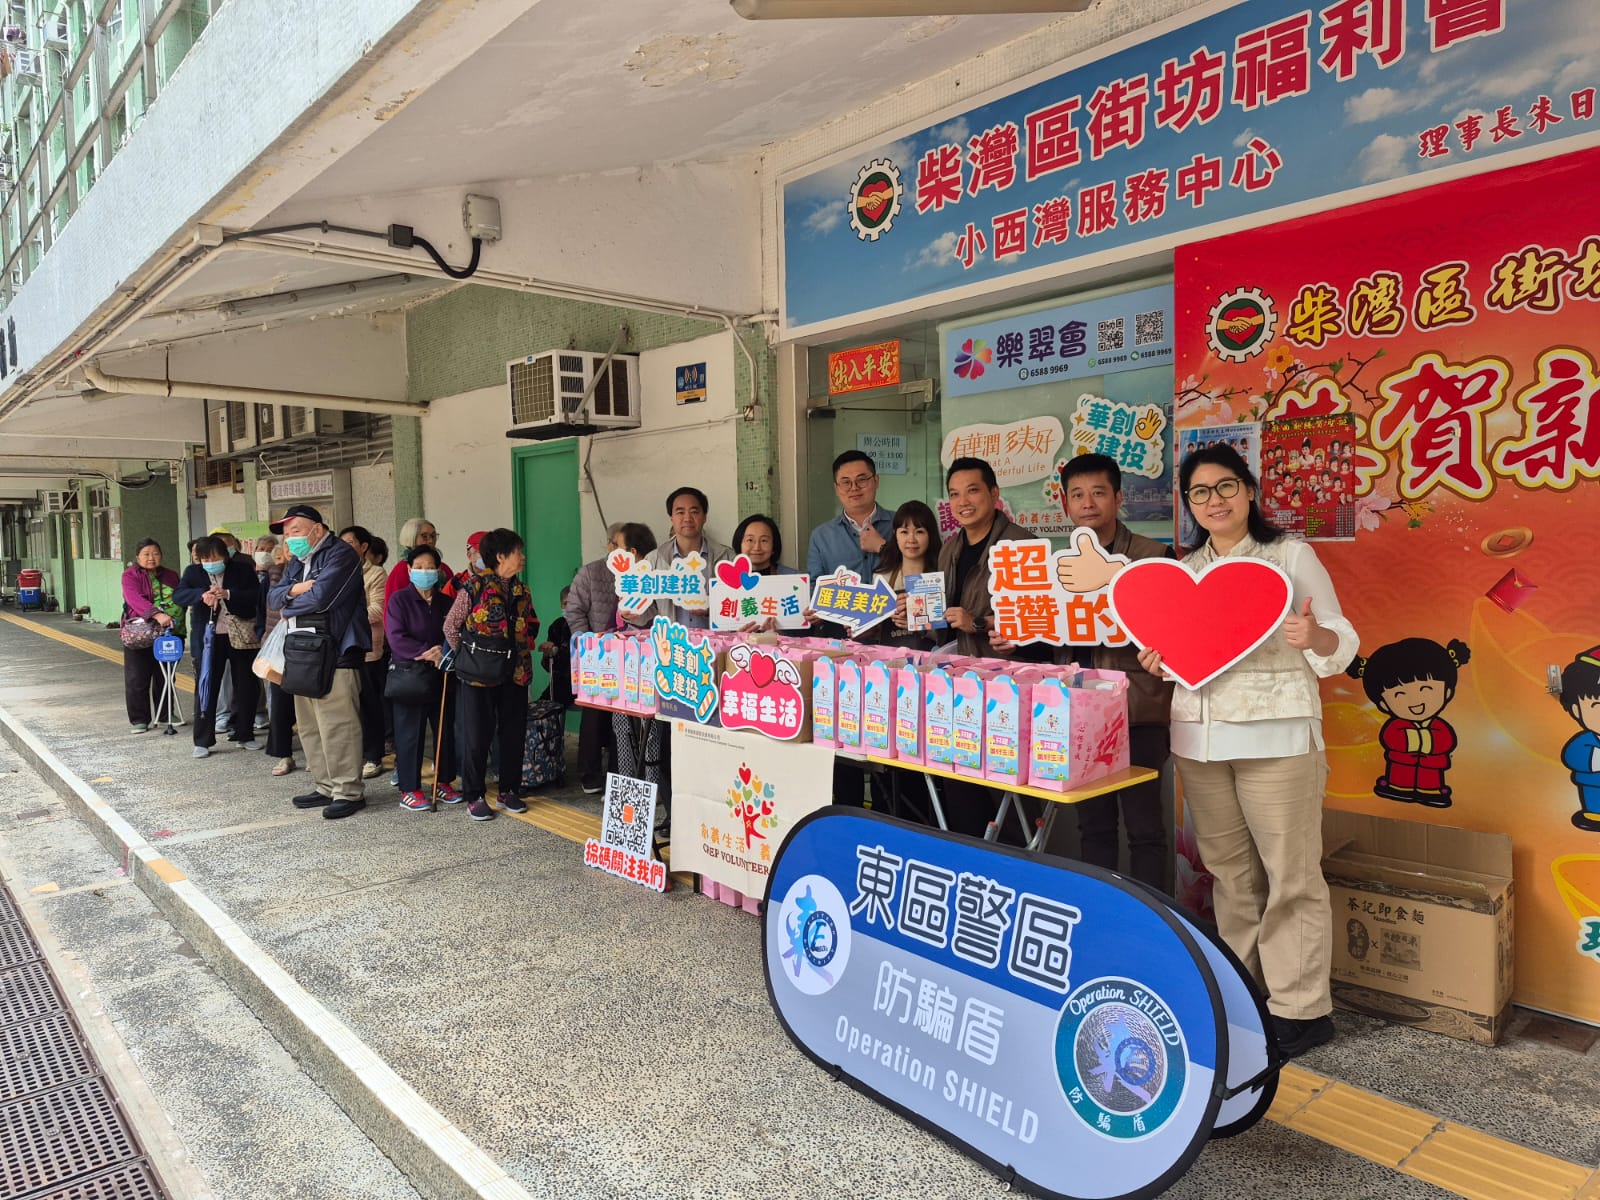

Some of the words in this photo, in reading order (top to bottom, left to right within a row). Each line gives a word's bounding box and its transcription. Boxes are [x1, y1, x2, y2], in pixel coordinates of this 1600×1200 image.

[954, 137, 1284, 269] 小西灣服務中心
[996, 320, 1088, 369] 樂翠會
[834, 350, 893, 386] 出入平安
[1030, 367, 1049, 377] 6588
[1050, 364, 1069, 375] 9969
[1086, 402, 1137, 437] 華創
[1005, 424, 1056, 457] 多美好
[1095, 434, 1147, 470] 建投
[996, 465, 1025, 477] derful
[1028, 462, 1046, 473] Life
[1004, 456, 1011, 466] A
[1040, 525, 1075, 533] VOLUNTE
[620, 574, 700, 595] 華創建投
[992, 544, 1053, 592] 超
[719, 594, 801, 619] 創義生活
[816, 586, 888, 616] 匯聚美好
[996, 594, 1127, 643] 讚的
[672, 644, 698, 676] 華創
[672, 671, 699, 703] 建投
[722, 689, 798, 728] 幸福生活
[586, 842, 664, 890] 掃碼關注我們
[851, 845, 1080, 993] 東區警區
[873, 960, 1005, 1067] 防騙盾
[1069, 984, 1126, 1016] Operation
[1129, 989, 1180, 1046] SHIELD
[835, 1014, 936, 1092] Operation
[942, 1069, 1040, 1145] SHIELD
